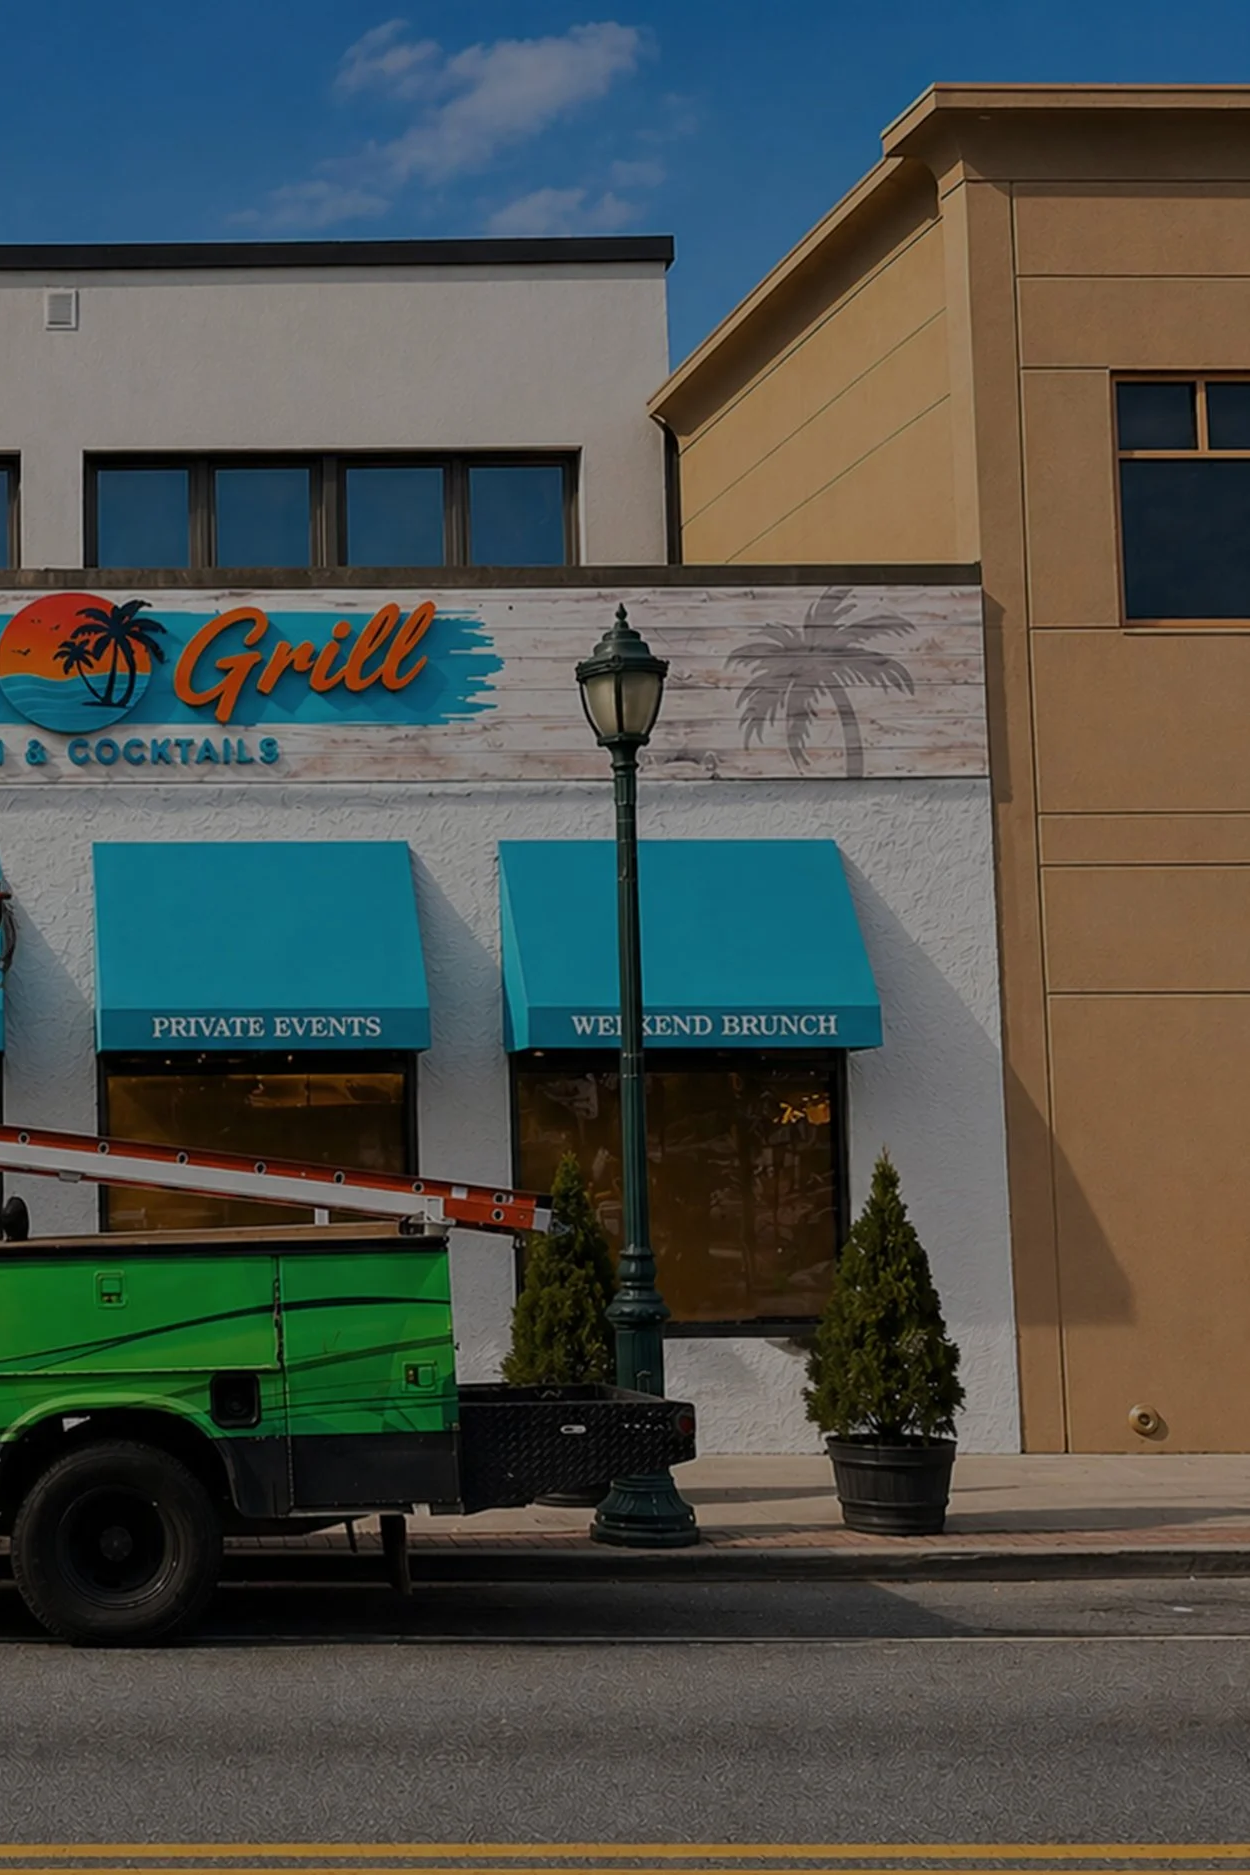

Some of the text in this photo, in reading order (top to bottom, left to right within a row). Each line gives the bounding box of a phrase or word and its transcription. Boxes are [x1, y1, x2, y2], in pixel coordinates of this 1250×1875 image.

[173, 601, 437, 723] Grill
[25, 739, 47, 766] &
[68, 737, 280, 766] COCKTAILS
[152, 1016, 382, 1039] PRIVATE EVENTS
[721, 1014, 839, 1037] BRUNCH
